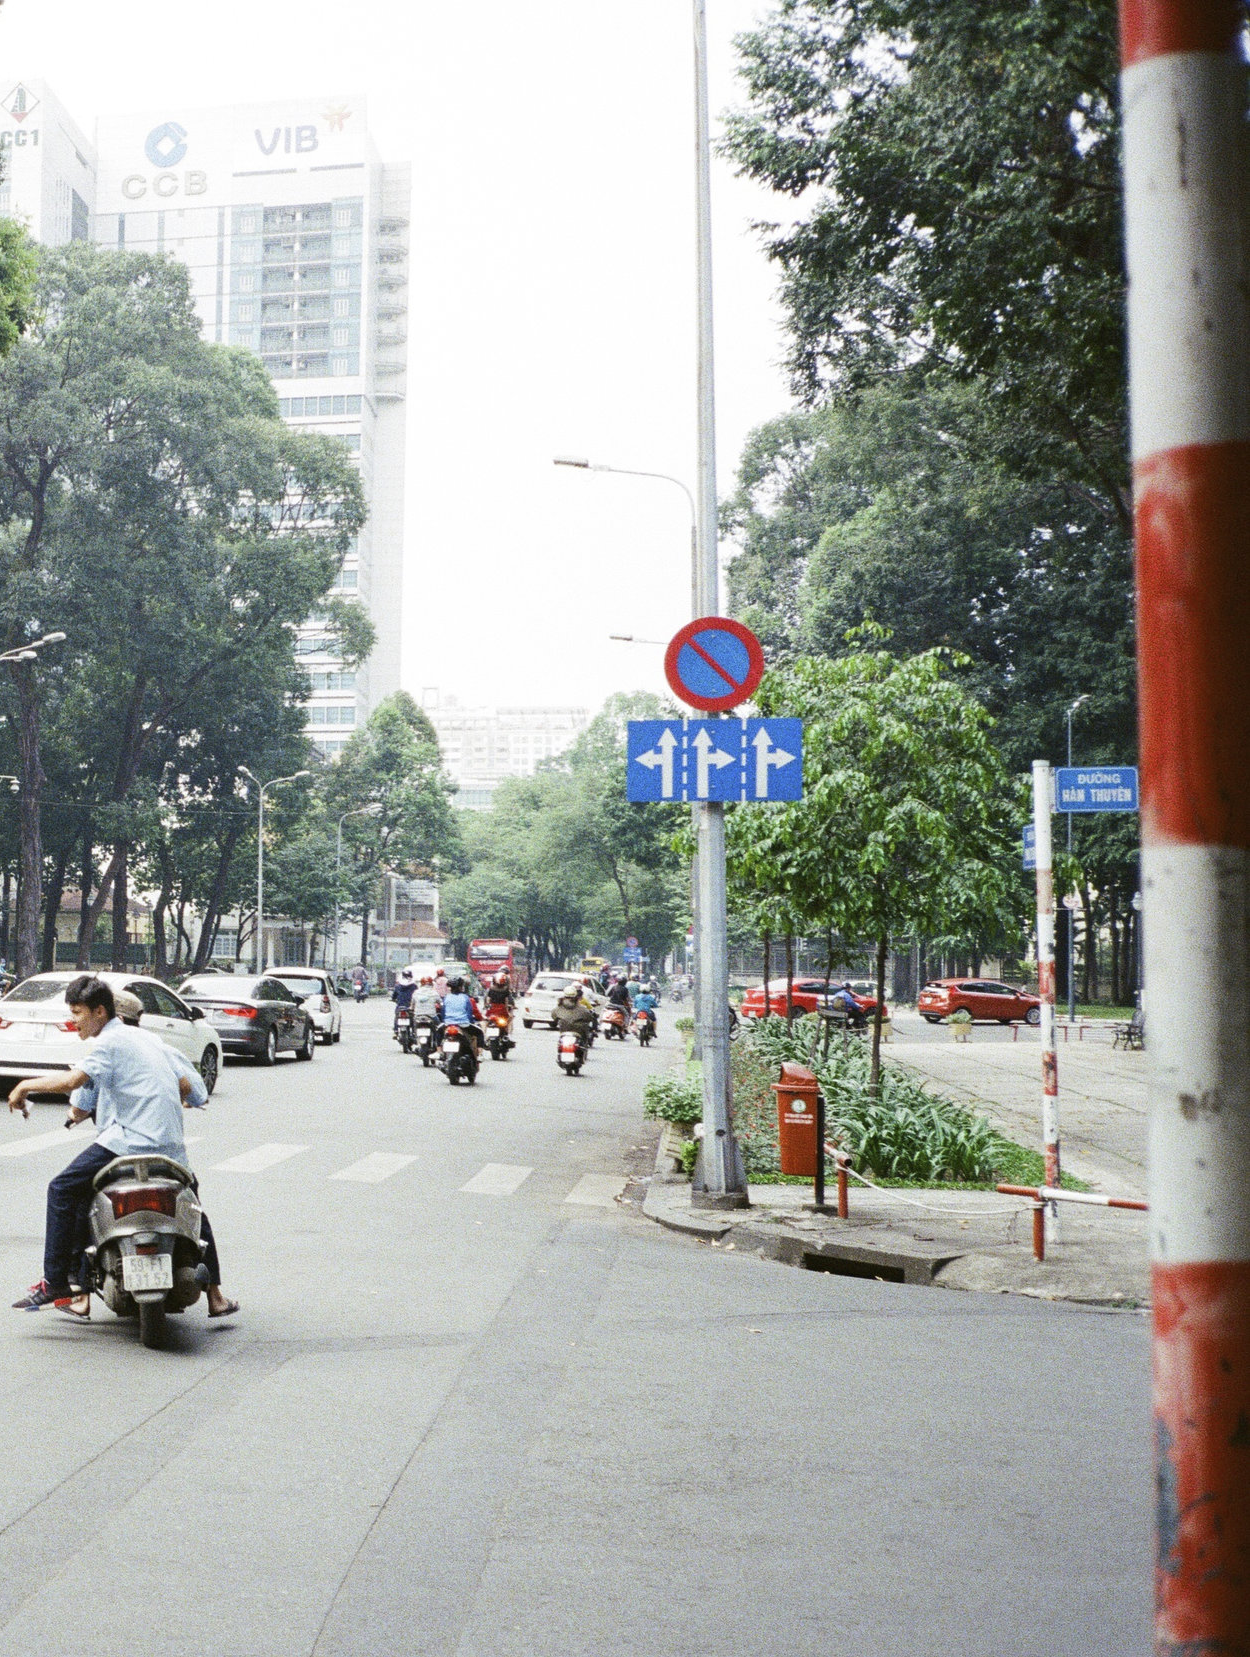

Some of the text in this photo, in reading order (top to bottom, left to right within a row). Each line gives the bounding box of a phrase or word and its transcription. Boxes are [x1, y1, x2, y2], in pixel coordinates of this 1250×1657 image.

[0, 129, 40, 149] CC1
[254, 125, 319, 156] VIB
[121, 170, 208, 200] CCB
[1077, 771, 1121, 784] ĐƯỜNG
